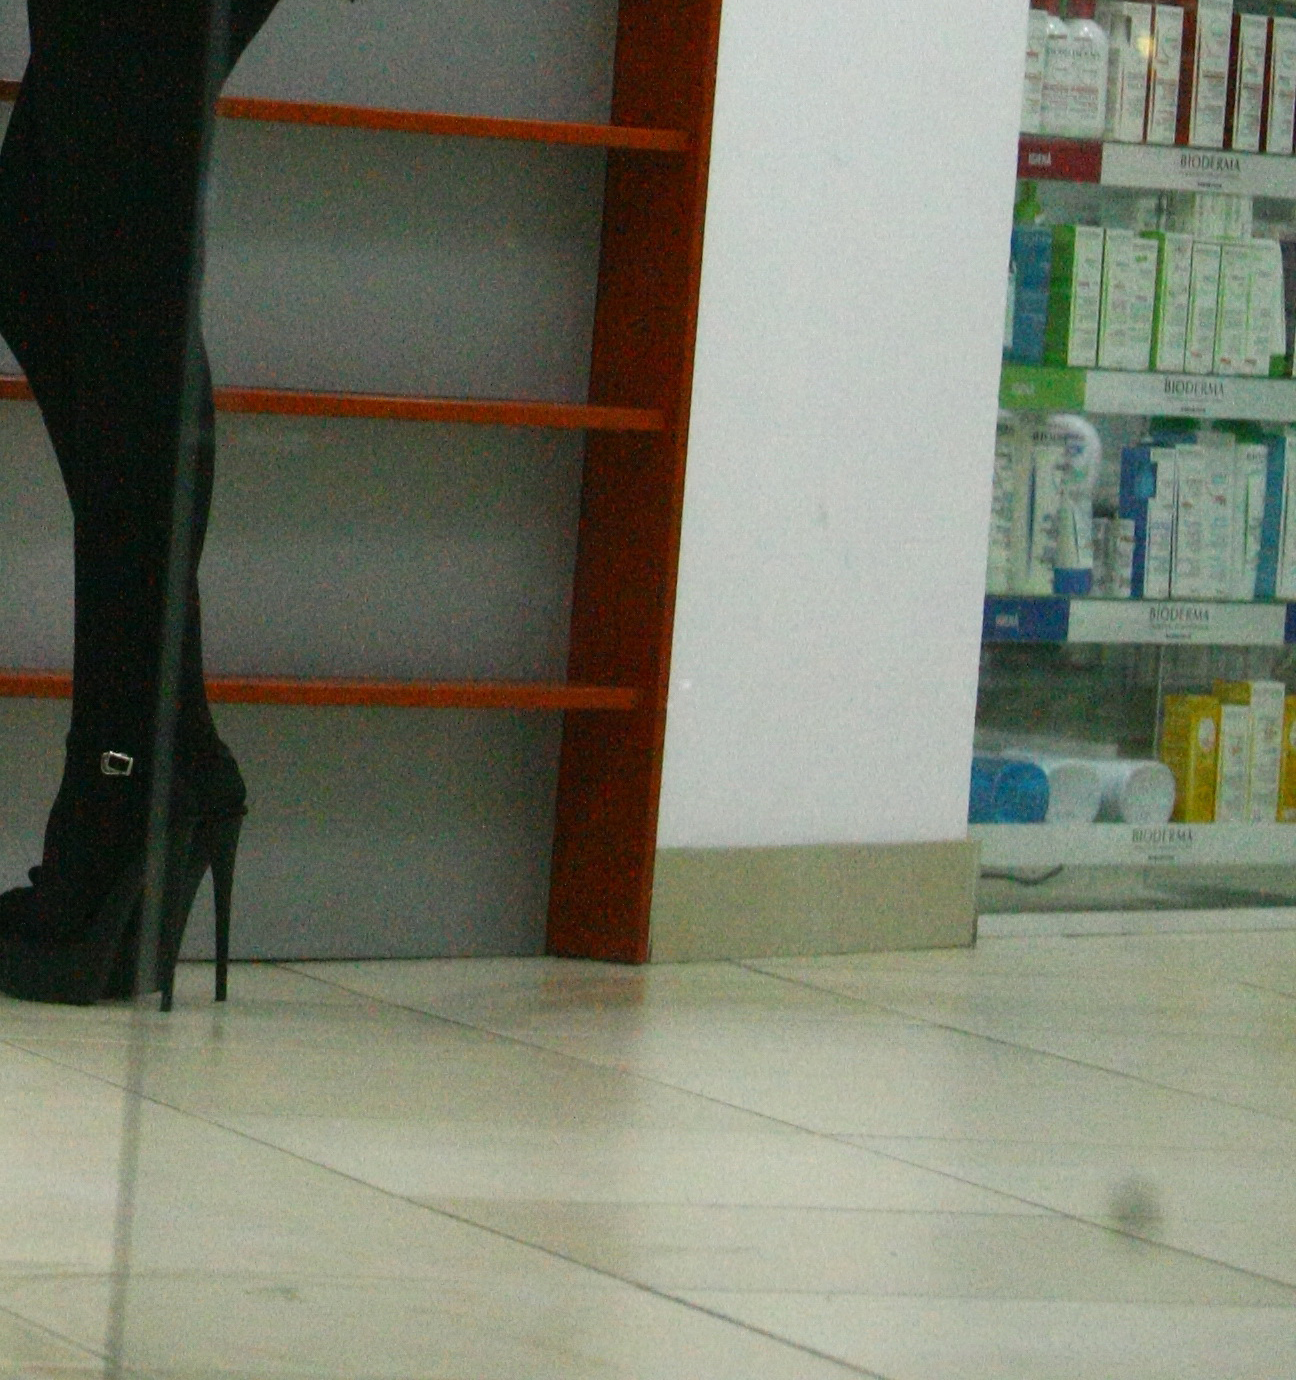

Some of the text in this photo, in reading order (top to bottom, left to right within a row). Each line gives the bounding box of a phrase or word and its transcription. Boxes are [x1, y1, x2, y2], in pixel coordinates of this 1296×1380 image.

[1180, 153, 1241, 173] BIODERMA
[1164, 377, 1224, 396] BIODERMA
[1149, 606, 1210, 622] BIODERMA
[1131, 828, 1193, 844] BIODERMA
